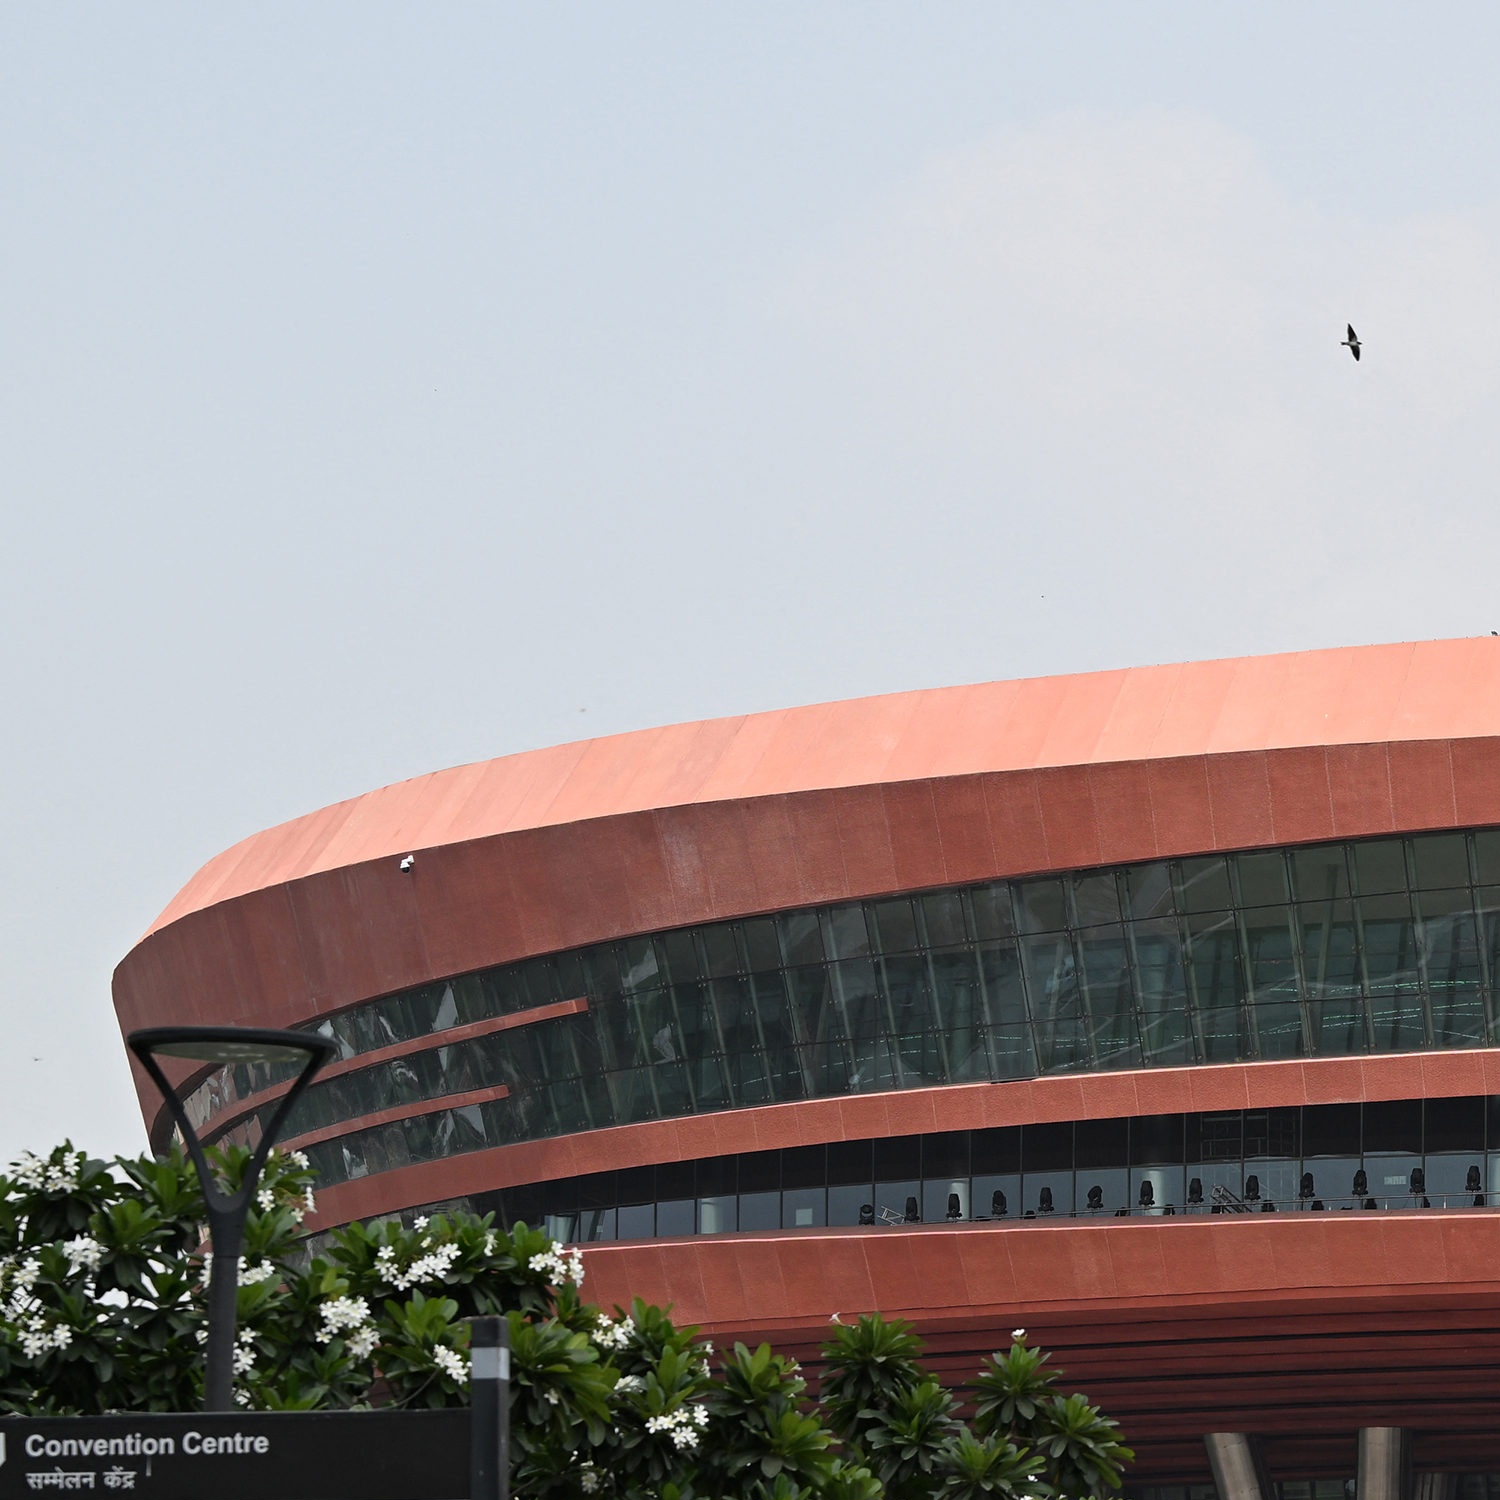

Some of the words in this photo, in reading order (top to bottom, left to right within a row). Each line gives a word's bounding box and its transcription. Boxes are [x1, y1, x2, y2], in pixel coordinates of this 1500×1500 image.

[24, 1432, 175, 1458] Convention
[182, 1431, 270, 1455] Centre
[25, 1466, 97, 1490] सम्मेलन
